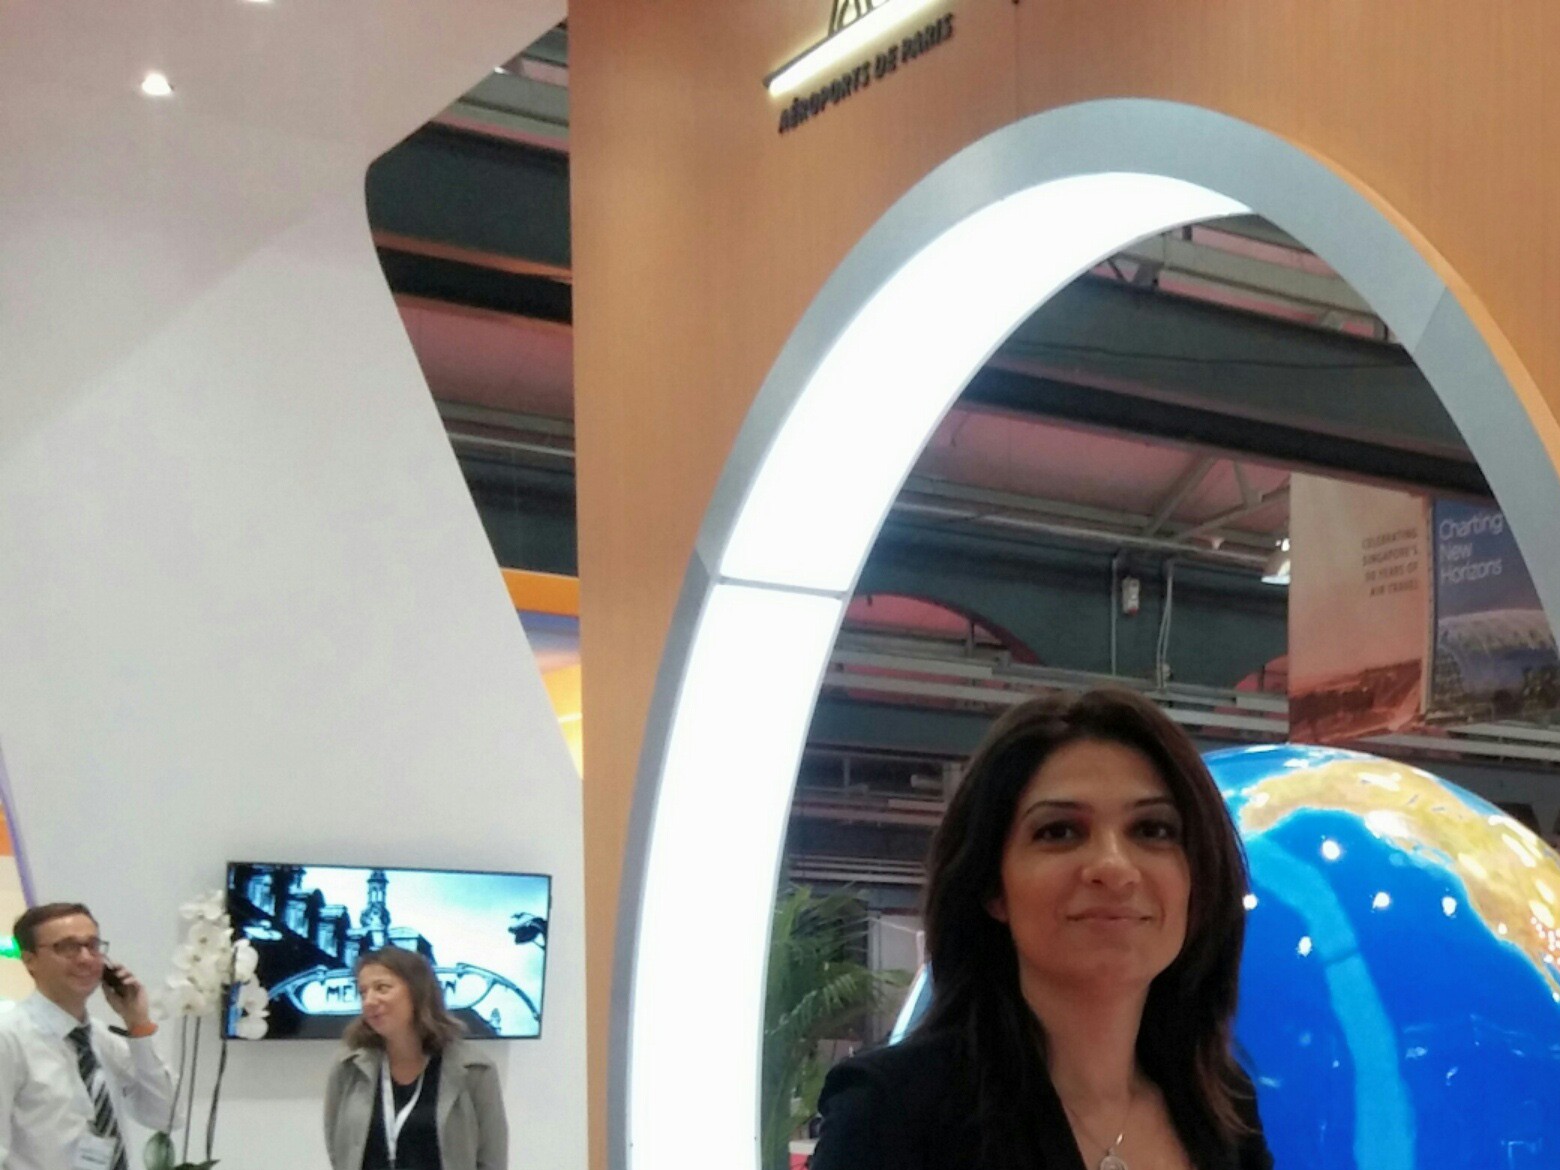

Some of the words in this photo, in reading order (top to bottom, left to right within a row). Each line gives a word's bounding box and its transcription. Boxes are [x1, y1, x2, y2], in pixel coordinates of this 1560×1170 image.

[874, 45, 898, 80] DE
[901, 12, 953, 63] PARIS
[1440, 513, 1503, 540] Charting
[1440, 542, 1473, 561] New
[1440, 559, 1503, 585] Horizons
